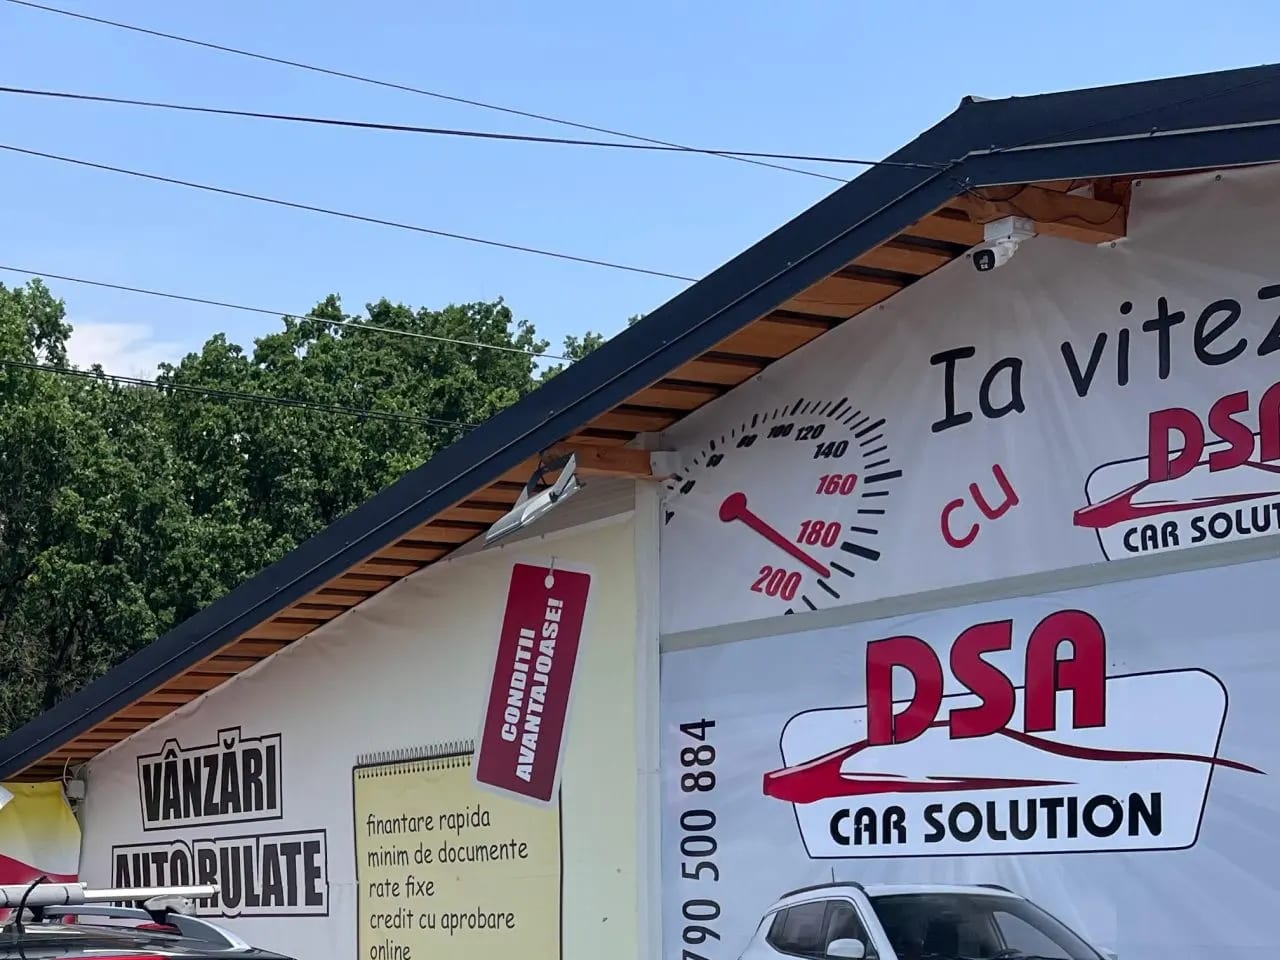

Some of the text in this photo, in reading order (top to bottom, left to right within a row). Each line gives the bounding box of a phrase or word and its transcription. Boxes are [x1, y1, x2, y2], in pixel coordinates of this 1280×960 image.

[930, 346, 1026, 433] Ia
[767, 422, 795, 439] 100
[795, 424, 826, 442] 120
[813, 440, 849, 460] 140
[816, 473, 858, 496] 160
[940, 463, 1019, 549] cu
[796, 519, 842, 548] 180
[1123, 520, 1180, 552] CAR
[750, 565, 802, 601] 200
[501, 627, 536, 742] CONDITII
[515, 597, 564, 783] AVANTAJOASE!
[866, 609, 1106, 746] DSA
[679, 718, 716, 794] 884
[142, 737, 277, 821] VÂNZĂRI
[367, 804, 491, 837] finantare rapida
[829, 791, 1162, 846] CAR SOLUTION
[368, 838, 529, 867] minim de documente
[679, 808, 720, 882] 500
[197, 840, 323, 908] RULATE
[369, 874, 435, 899] rate fixe
[370, 906, 516, 936] credit cu aprobare
[370, 938, 411, 960] online
